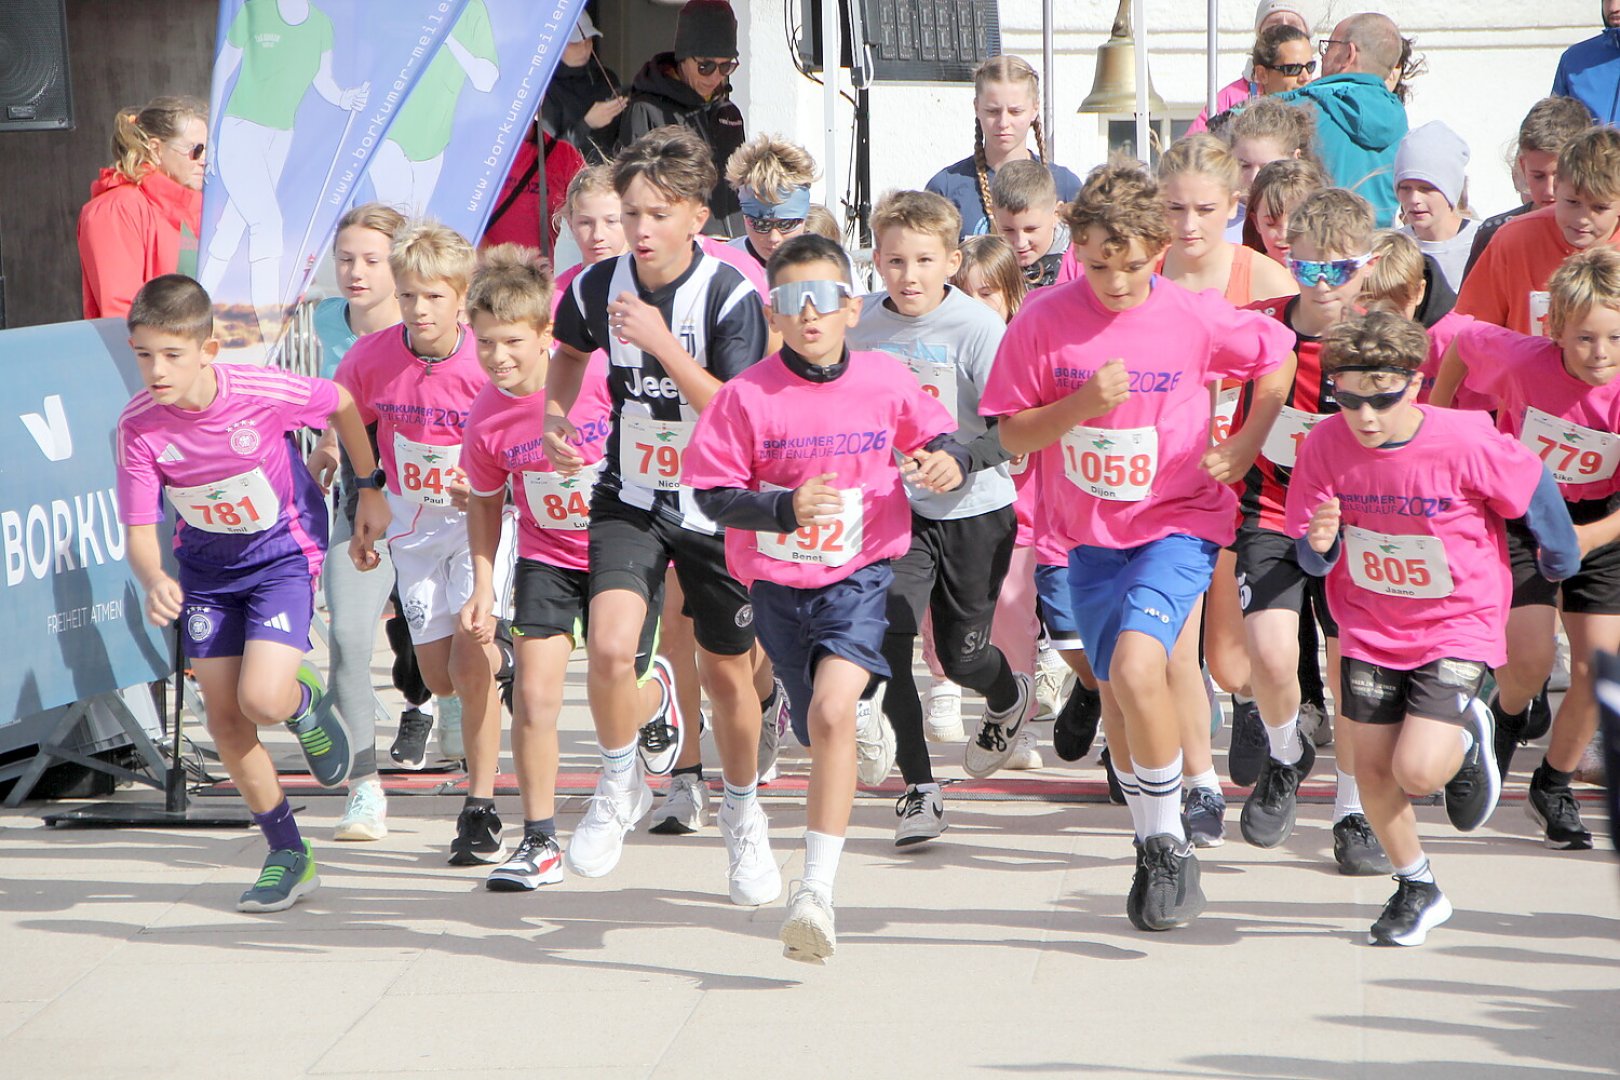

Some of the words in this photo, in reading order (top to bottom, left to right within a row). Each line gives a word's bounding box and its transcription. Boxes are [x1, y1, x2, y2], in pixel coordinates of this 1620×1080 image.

[565, 416, 609, 447] 026
[763, 436, 834, 449] BORKUMER
[833, 430, 887, 456] 2026
[635, 441, 683, 477] 79
[1065, 444, 1151, 487] 1058
[1537, 435, 1603, 475] 779
[658, 480, 680, 488] Nico
[1091, 486, 1116, 498] Dijon
[190, 495, 260, 526] 781
[423, 496, 444, 504] Paul
[1, 488, 126, 587] BORKU
[791, 552, 823, 562] Benet
[1363, 551, 1431, 587] 805
[47, 606, 88, 635] FREIHEIT
[90, 599, 123, 625] ATMEN
